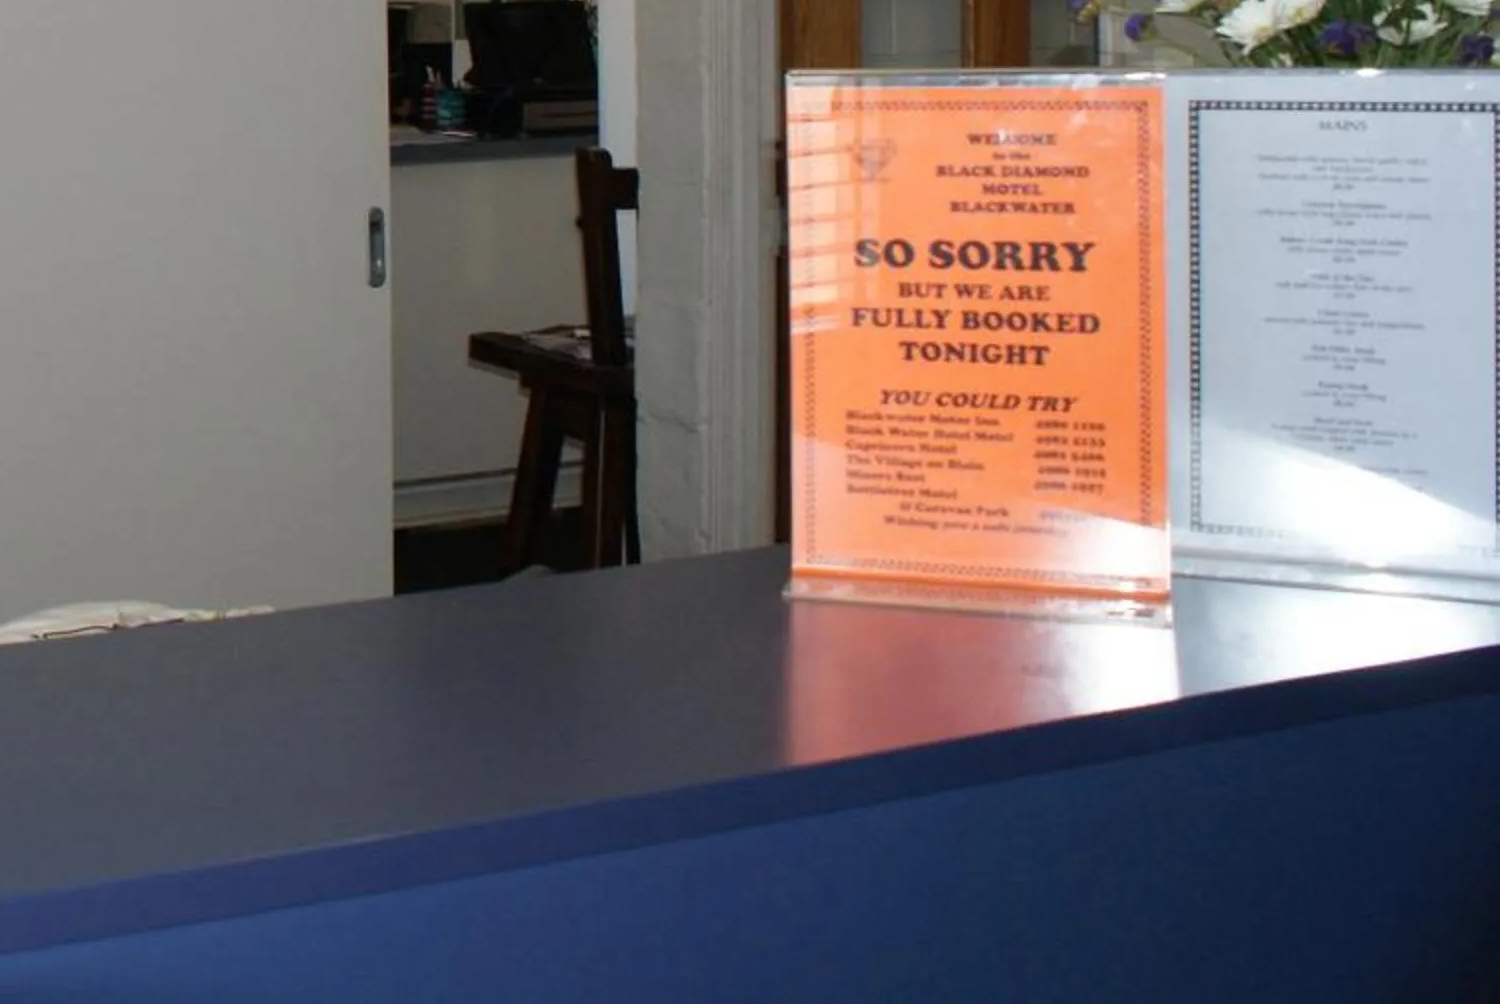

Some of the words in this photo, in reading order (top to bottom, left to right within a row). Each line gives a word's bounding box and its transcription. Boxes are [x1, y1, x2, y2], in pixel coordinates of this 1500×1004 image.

[936, 164, 996, 177] BLACK
[1001, 165, 1090, 178] DIAMOND
[981, 183, 1043, 196] MOTEL
[949, 201, 1077, 214] BLACKWATER
[854, 238, 915, 269] SO
[928, 240, 1096, 272] SORRY
[898, 282, 947, 299] BUT
[954, 284, 993, 300] WE
[999, 285, 1051, 302] ARE
[852, 307, 952, 330] FULLY
[961, 309, 1101, 334] BOOKED
[899, 341, 1052, 366] TONIGHT
[879, 389, 932, 408] YOU
[935, 391, 1021, 411] COULD
[1026, 395, 1080, 413] TRY
